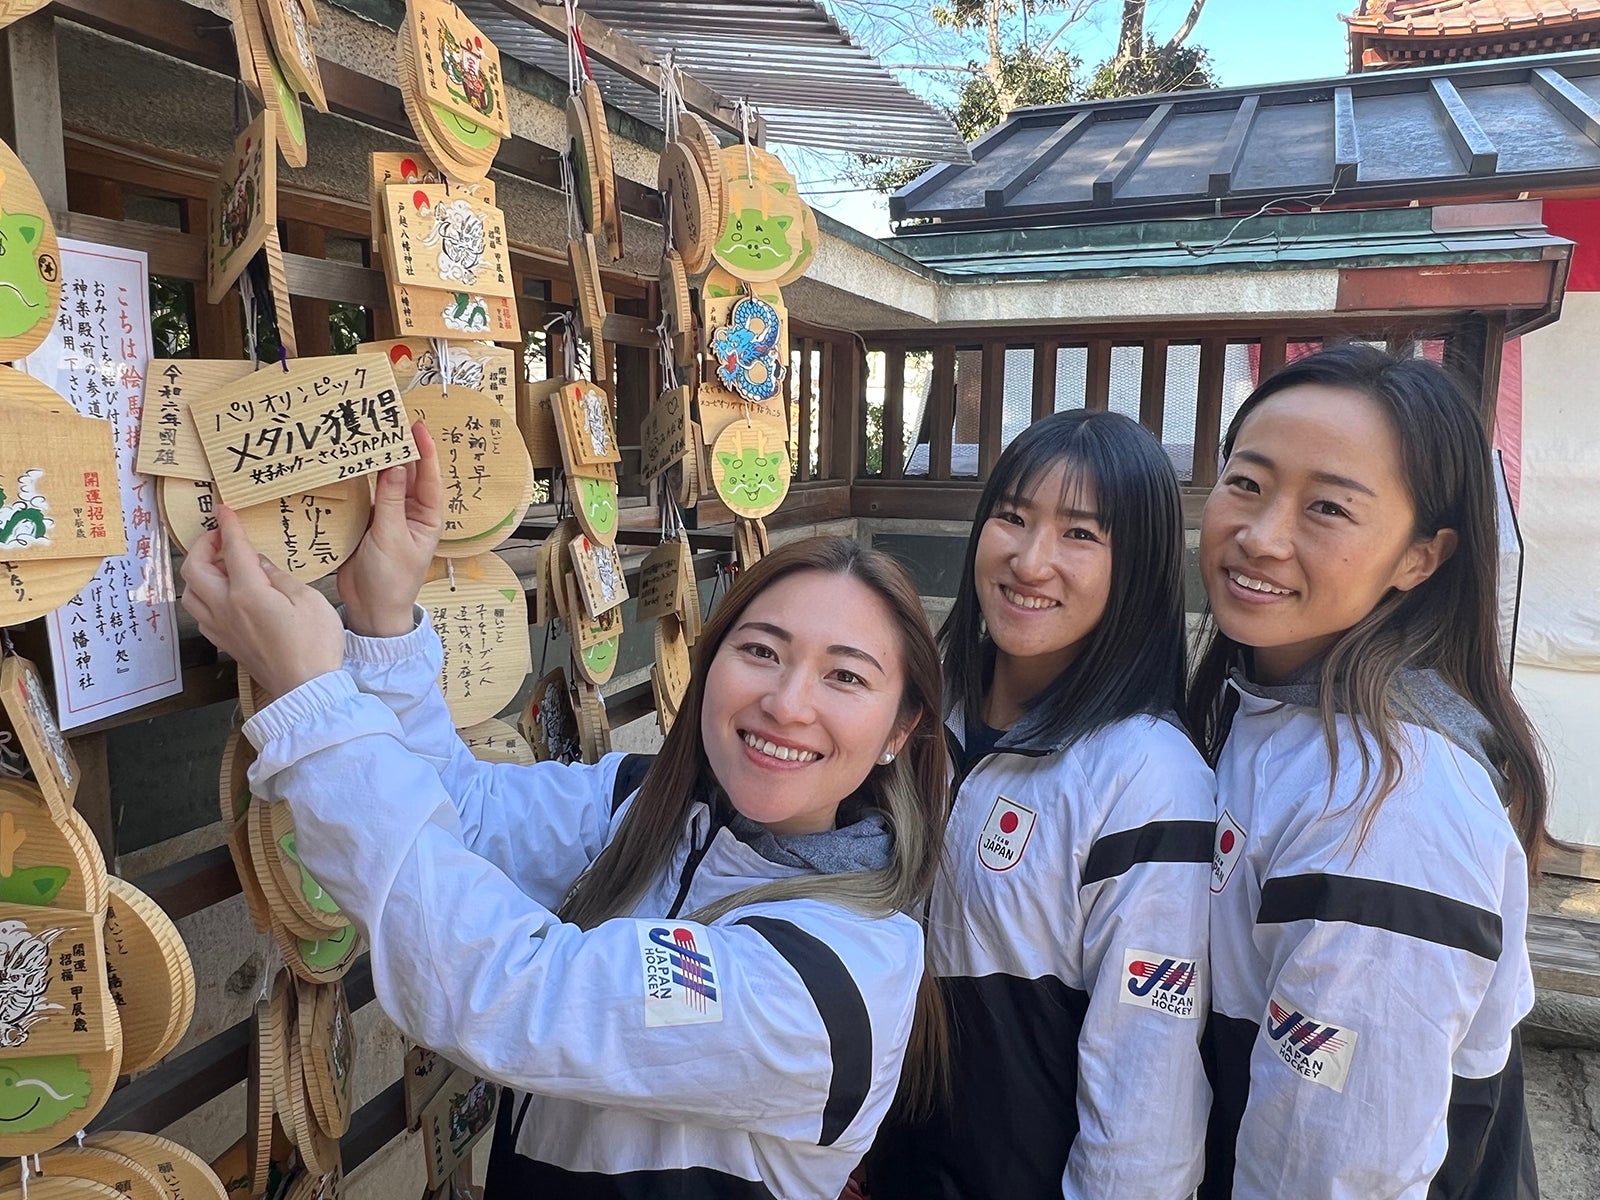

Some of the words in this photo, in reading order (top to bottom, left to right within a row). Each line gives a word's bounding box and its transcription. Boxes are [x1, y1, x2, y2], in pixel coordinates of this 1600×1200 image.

[398, 202, 415, 276] 戸越八幡神社
[226, 389, 401, 474] メダル獲得
[84, 472, 107, 538] 開運招福
[983, 839, 1014, 861] JAPAN
[993, 834, 1010, 846] TEAM
[60, 953, 73, 981] 招福
[73, 943, 87, 972] 開運
[644, 948, 659, 999] HOCKEY
[655, 948, 672, 999] JAPAN
[70, 986, 88, 1033] 甲辰歳
[1151, 999, 1192, 1015] HOCKEY
[1152, 990, 1194, 1007] JAPAN
[1279, 1047, 1321, 1078] HOCKEY
[1281, 1039, 1324, 1071] JAPAN
